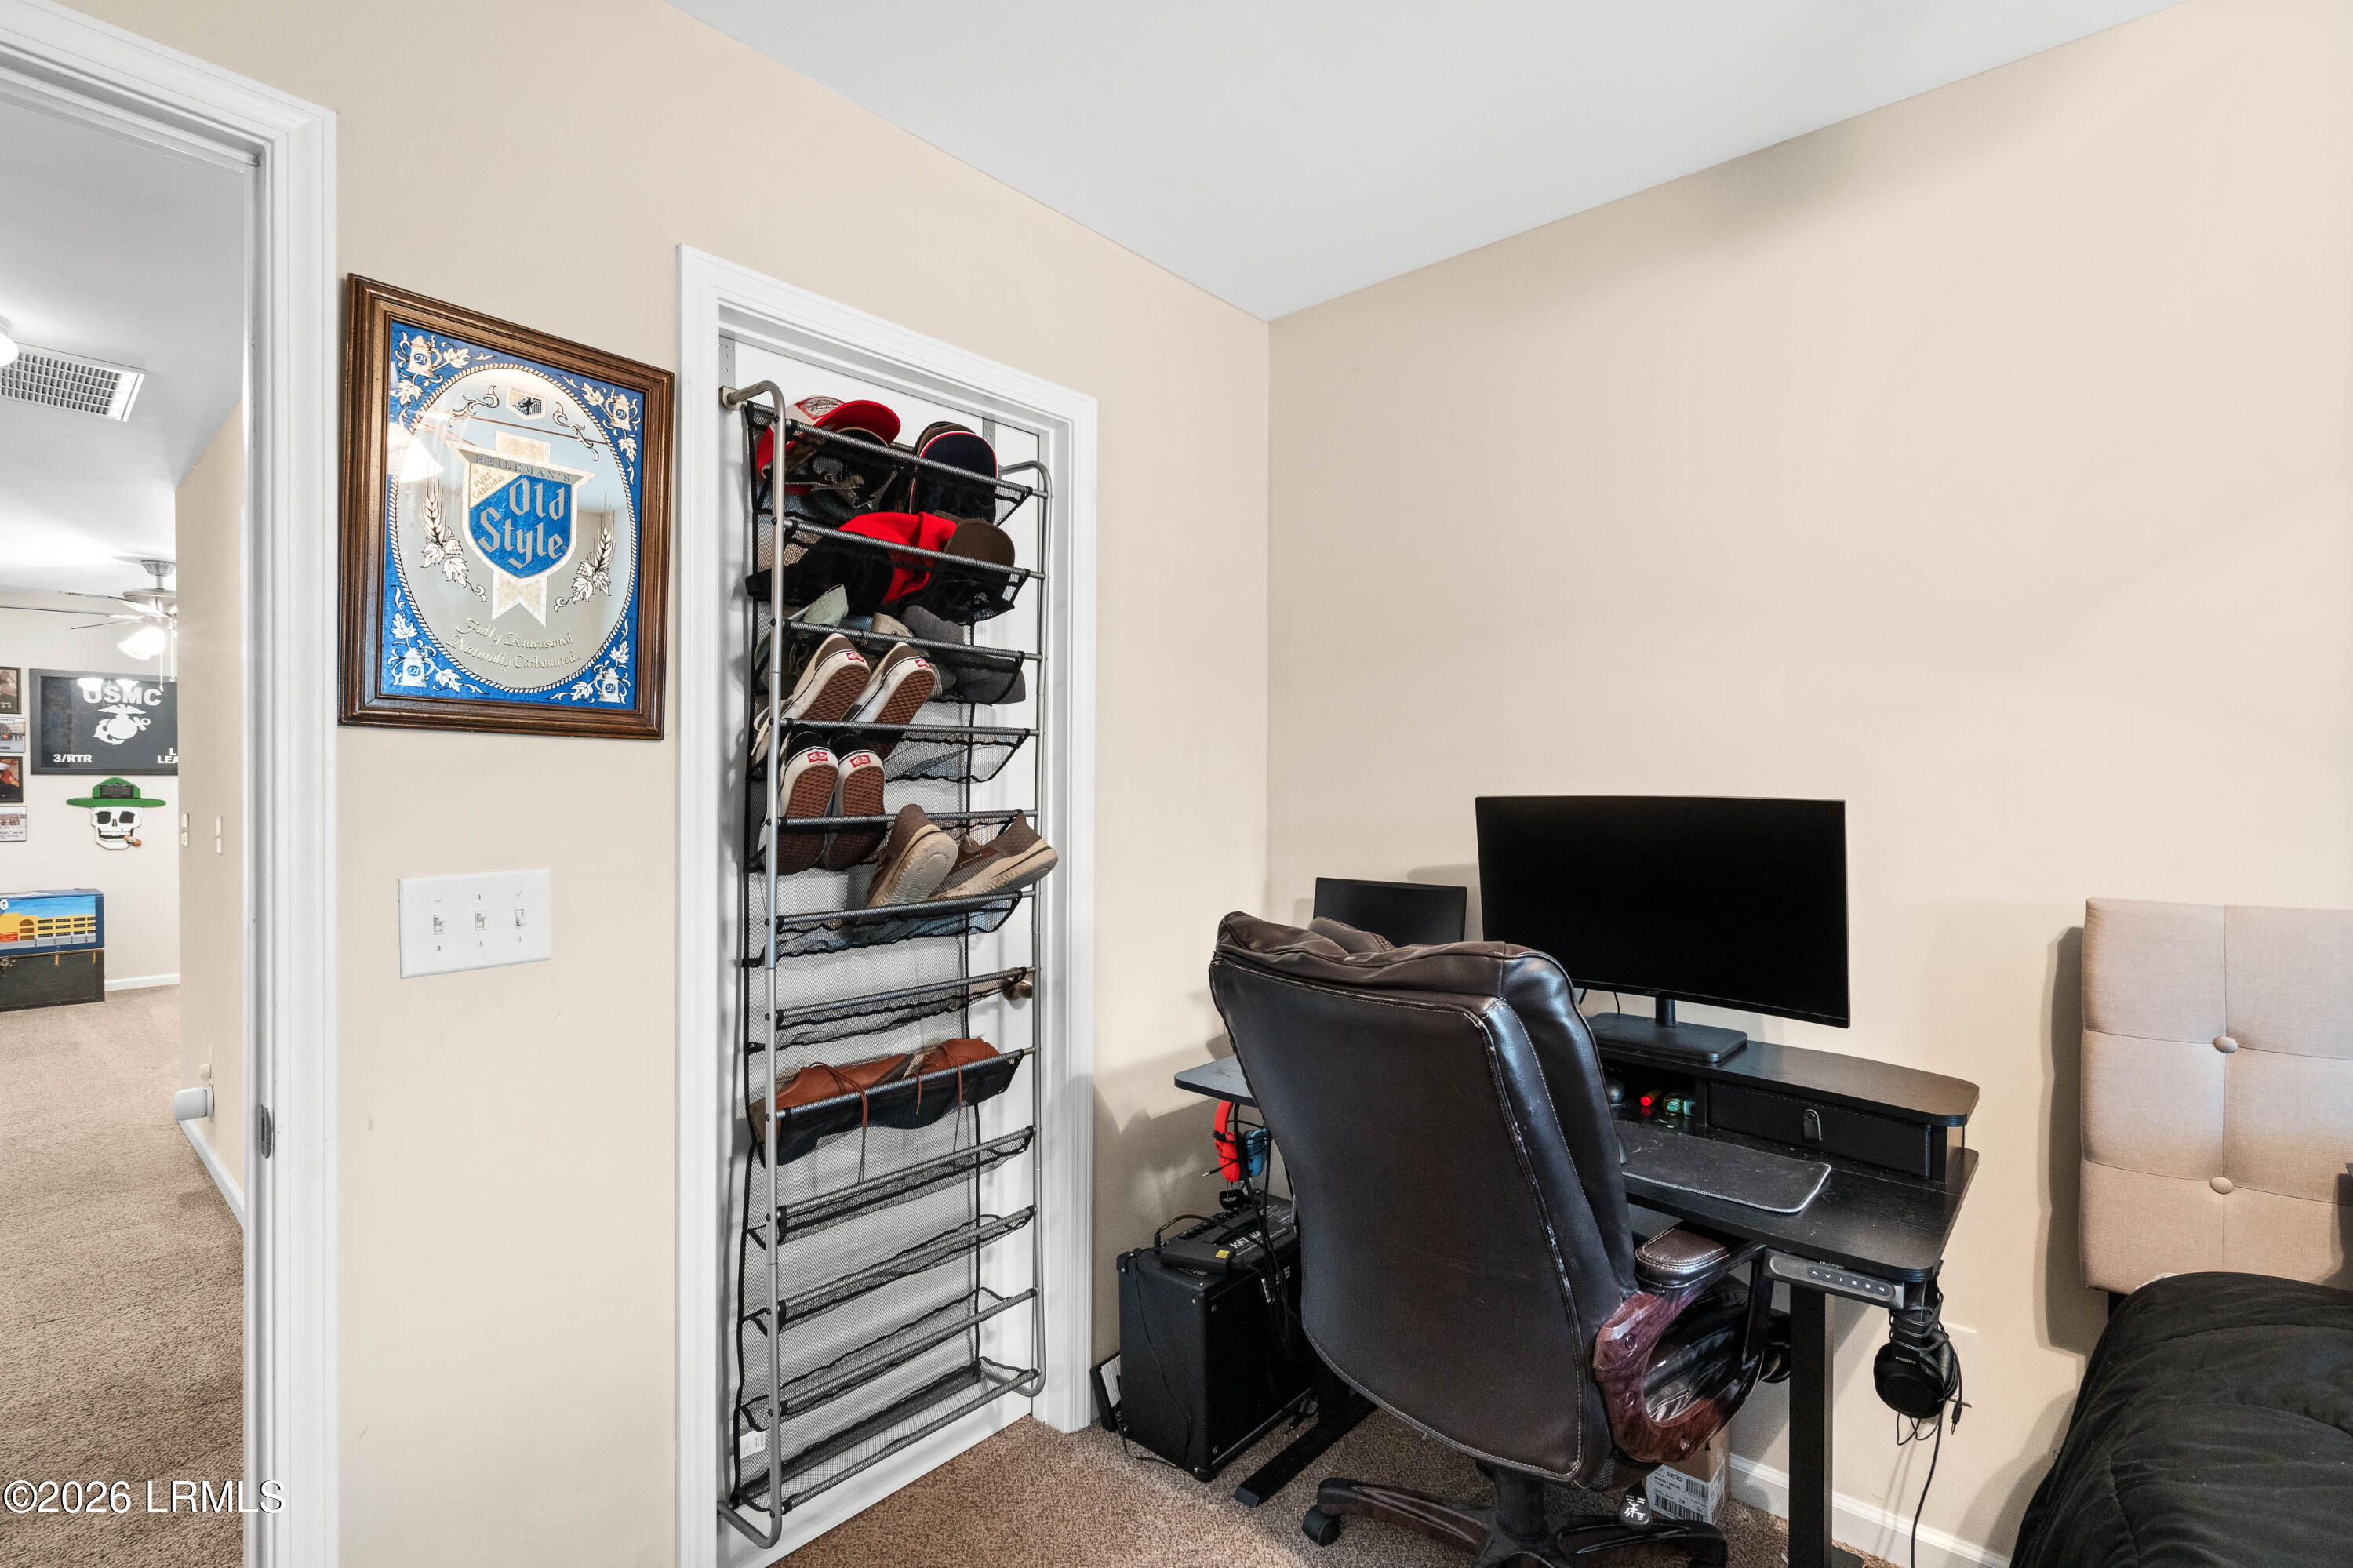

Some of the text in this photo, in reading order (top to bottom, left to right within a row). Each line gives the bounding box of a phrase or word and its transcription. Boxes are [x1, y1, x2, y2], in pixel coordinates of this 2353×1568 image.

[472, 471, 493, 488] PURE
[476, 454, 570, 483] HEILEMAN'S
[471, 475, 504, 500] GENUINE
[509, 477, 565, 522] Old
[478, 506, 564, 569] Style
[456, 617, 503, 647] Fully
[445, 634, 577, 672] Naturally Carbonated
[82, 684, 162, 706] USMC
[53, 754, 93, 763] 3/RTR
[1667, 1472, 1682, 1482] 5200
